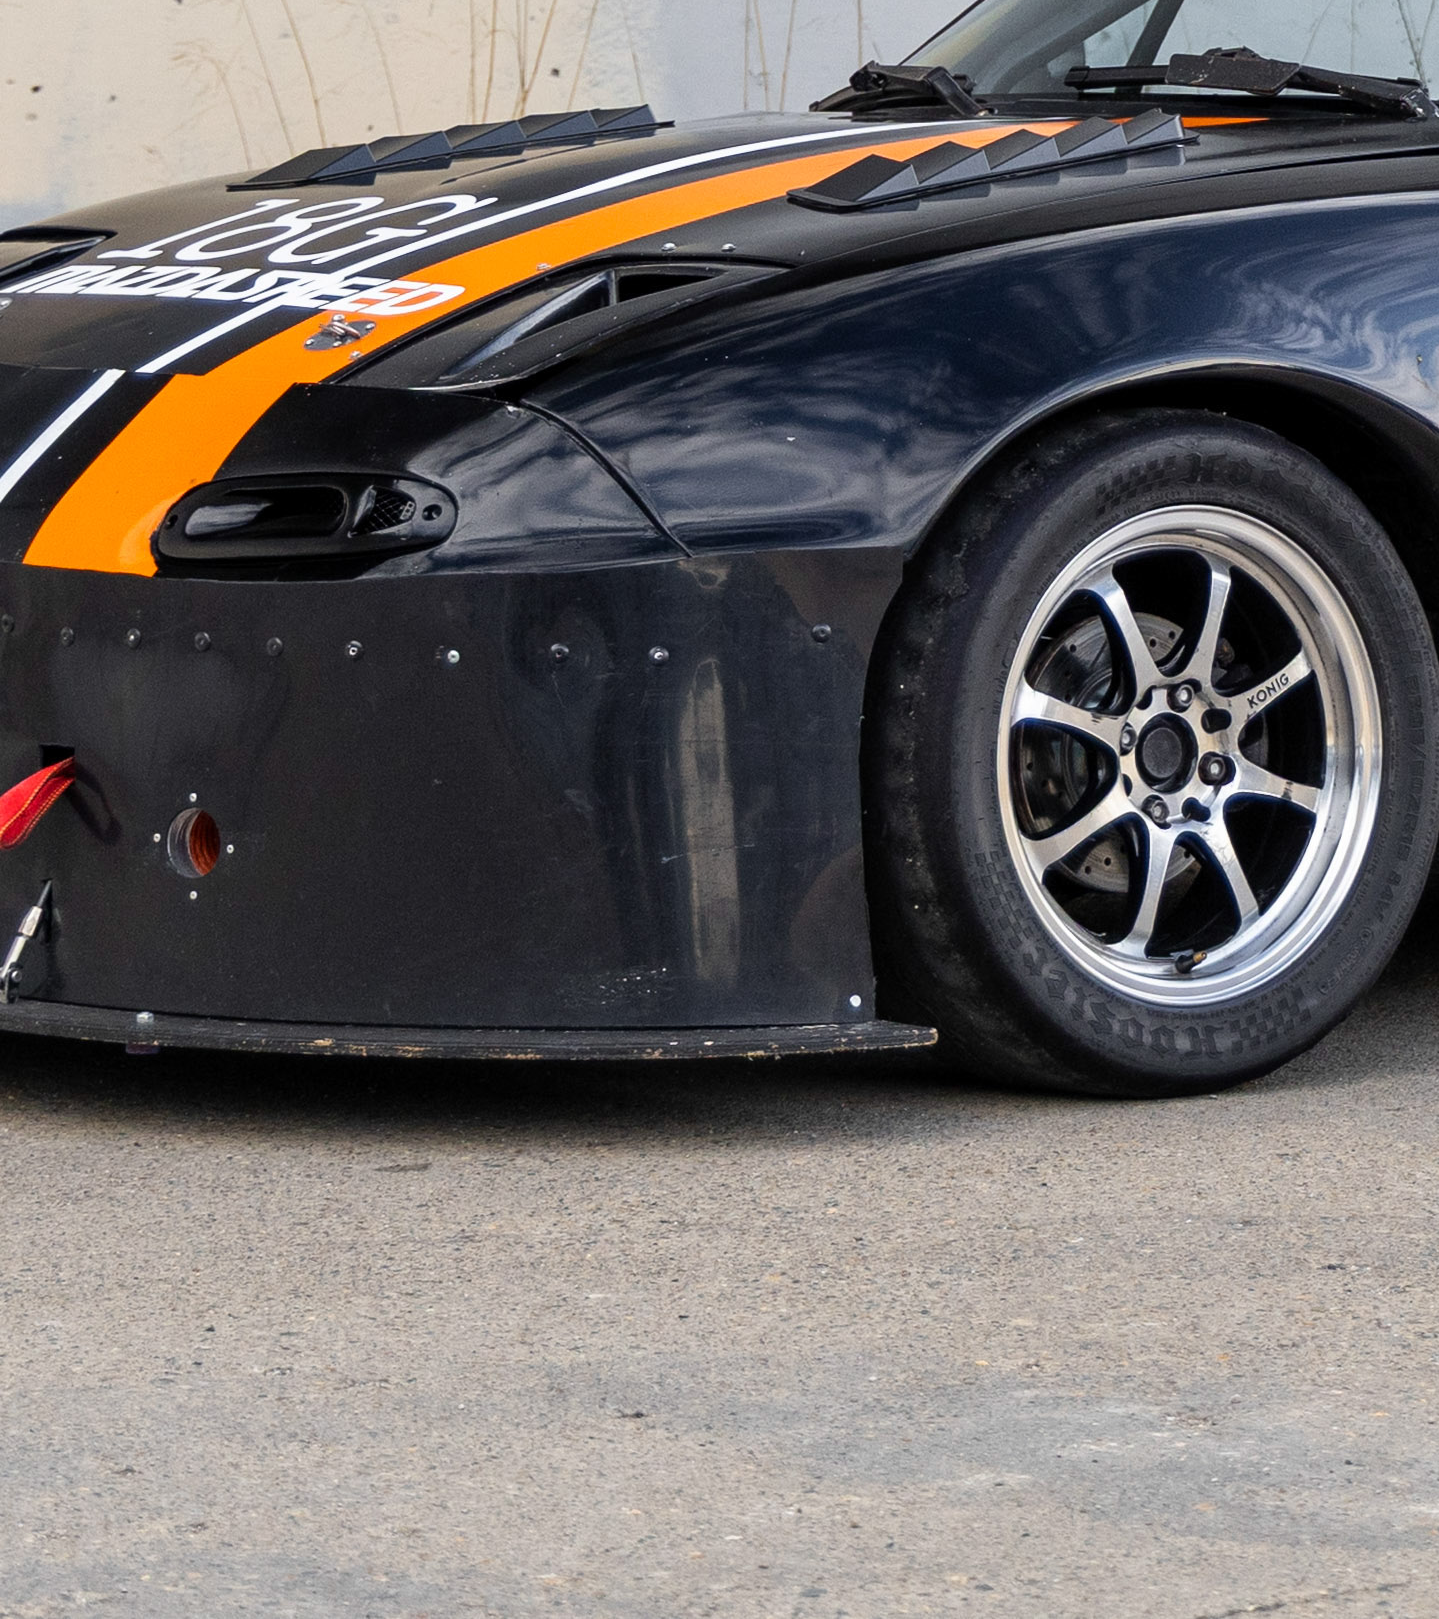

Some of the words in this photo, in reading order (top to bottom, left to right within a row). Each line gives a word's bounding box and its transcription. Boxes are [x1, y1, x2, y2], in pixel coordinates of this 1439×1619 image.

[97, 195, 499, 265] 18G
[1247, 673, 1289, 709] KONIG
[1017, 937, 1227, 1060] Hoosier
